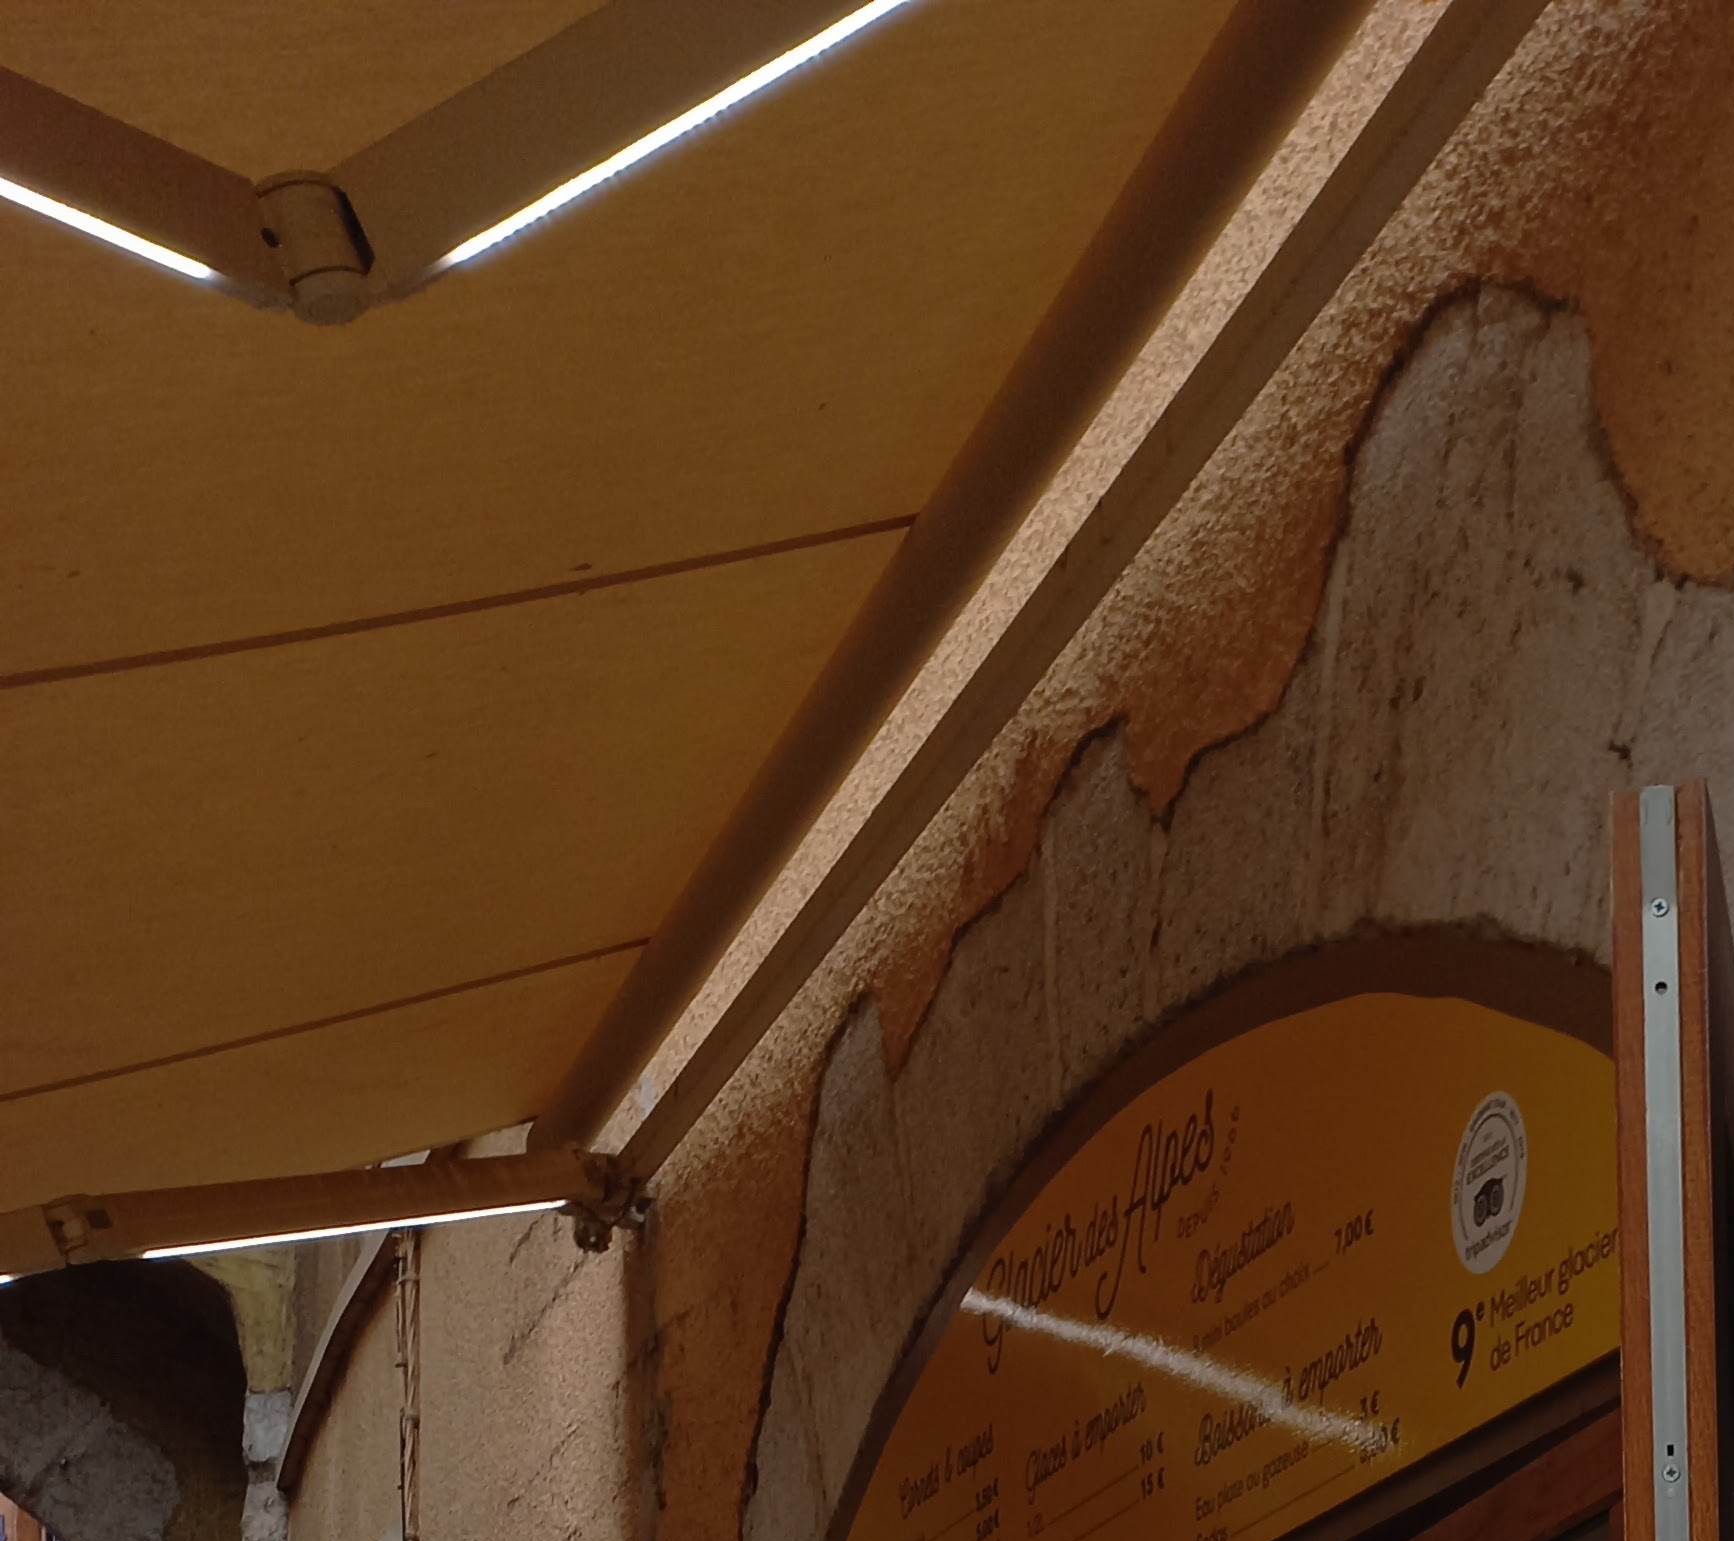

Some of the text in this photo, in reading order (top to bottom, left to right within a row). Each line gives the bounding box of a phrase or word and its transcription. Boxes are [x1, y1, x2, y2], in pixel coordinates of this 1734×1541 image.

[1084, 1194, 1119, 1268] des
[1094, 1088, 1216, 1322] Alpes
[1489, 1267, 1556, 1329] Meilleur
[1298, 1317, 1384, 1407] emporter
[1489, 1302, 1576, 1372] de France
